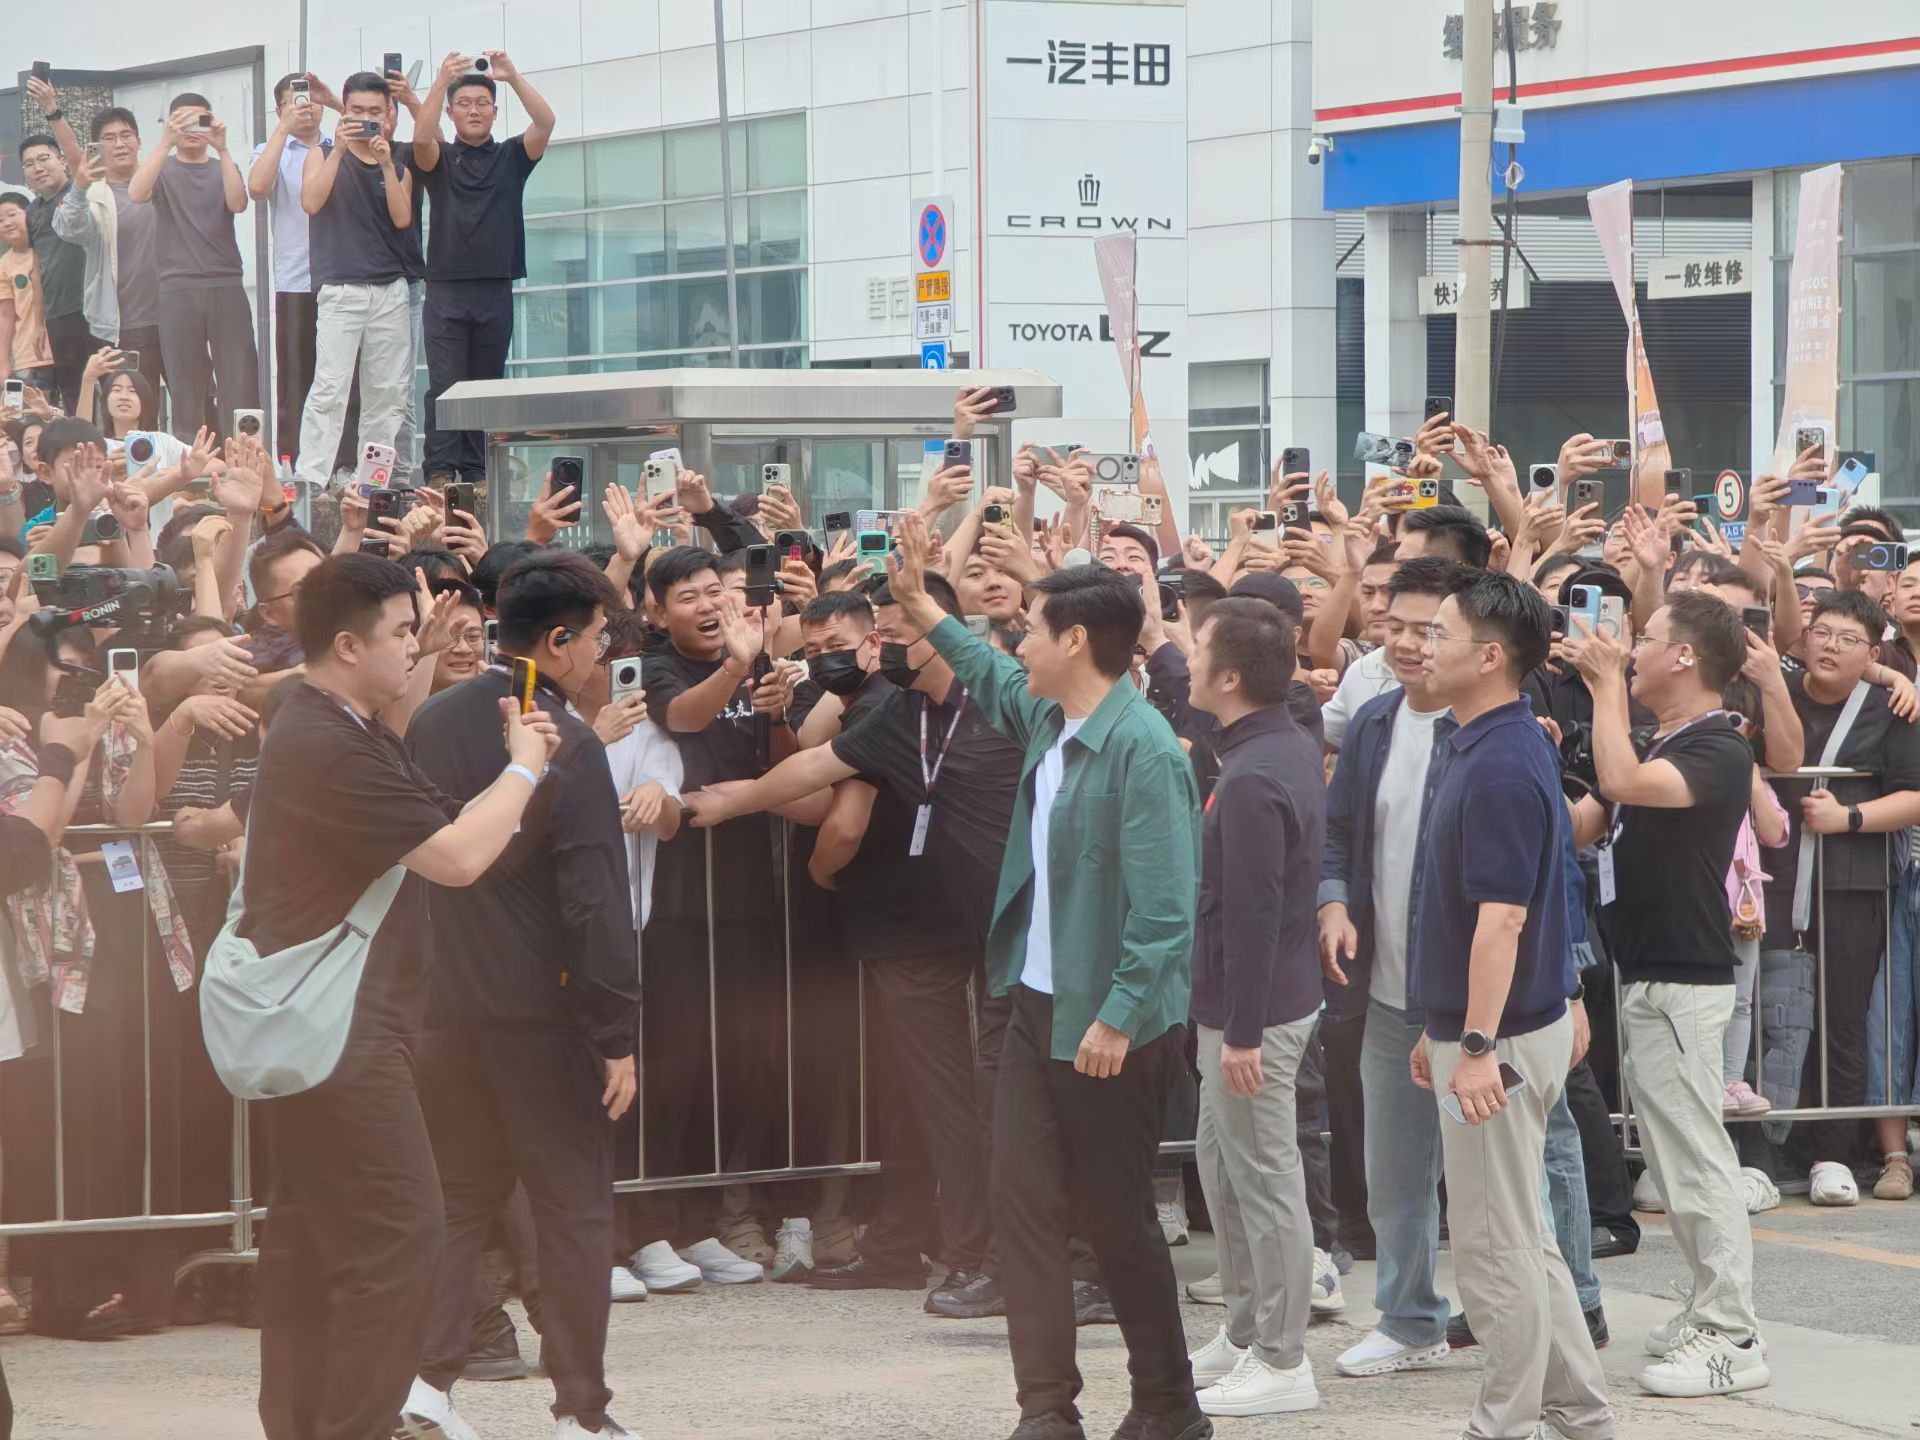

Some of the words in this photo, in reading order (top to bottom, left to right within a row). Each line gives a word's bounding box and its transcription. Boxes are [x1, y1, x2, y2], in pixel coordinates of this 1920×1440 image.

[1443, 2, 1562, 61] 维服务
[1006, 40, 1171, 86] 一汽丰田
[1007, 215, 1171, 230] CROWN
[1665, 260, 1743, 288] 一般维修
[1434, 278, 1505, 306] 快养
[1008, 323, 1093, 342] TOYOTA
[1724, 482, 1734, 508] 5
[81, 600, 120, 621] RONIN
[1706, 1353, 1734, 1388] NY
